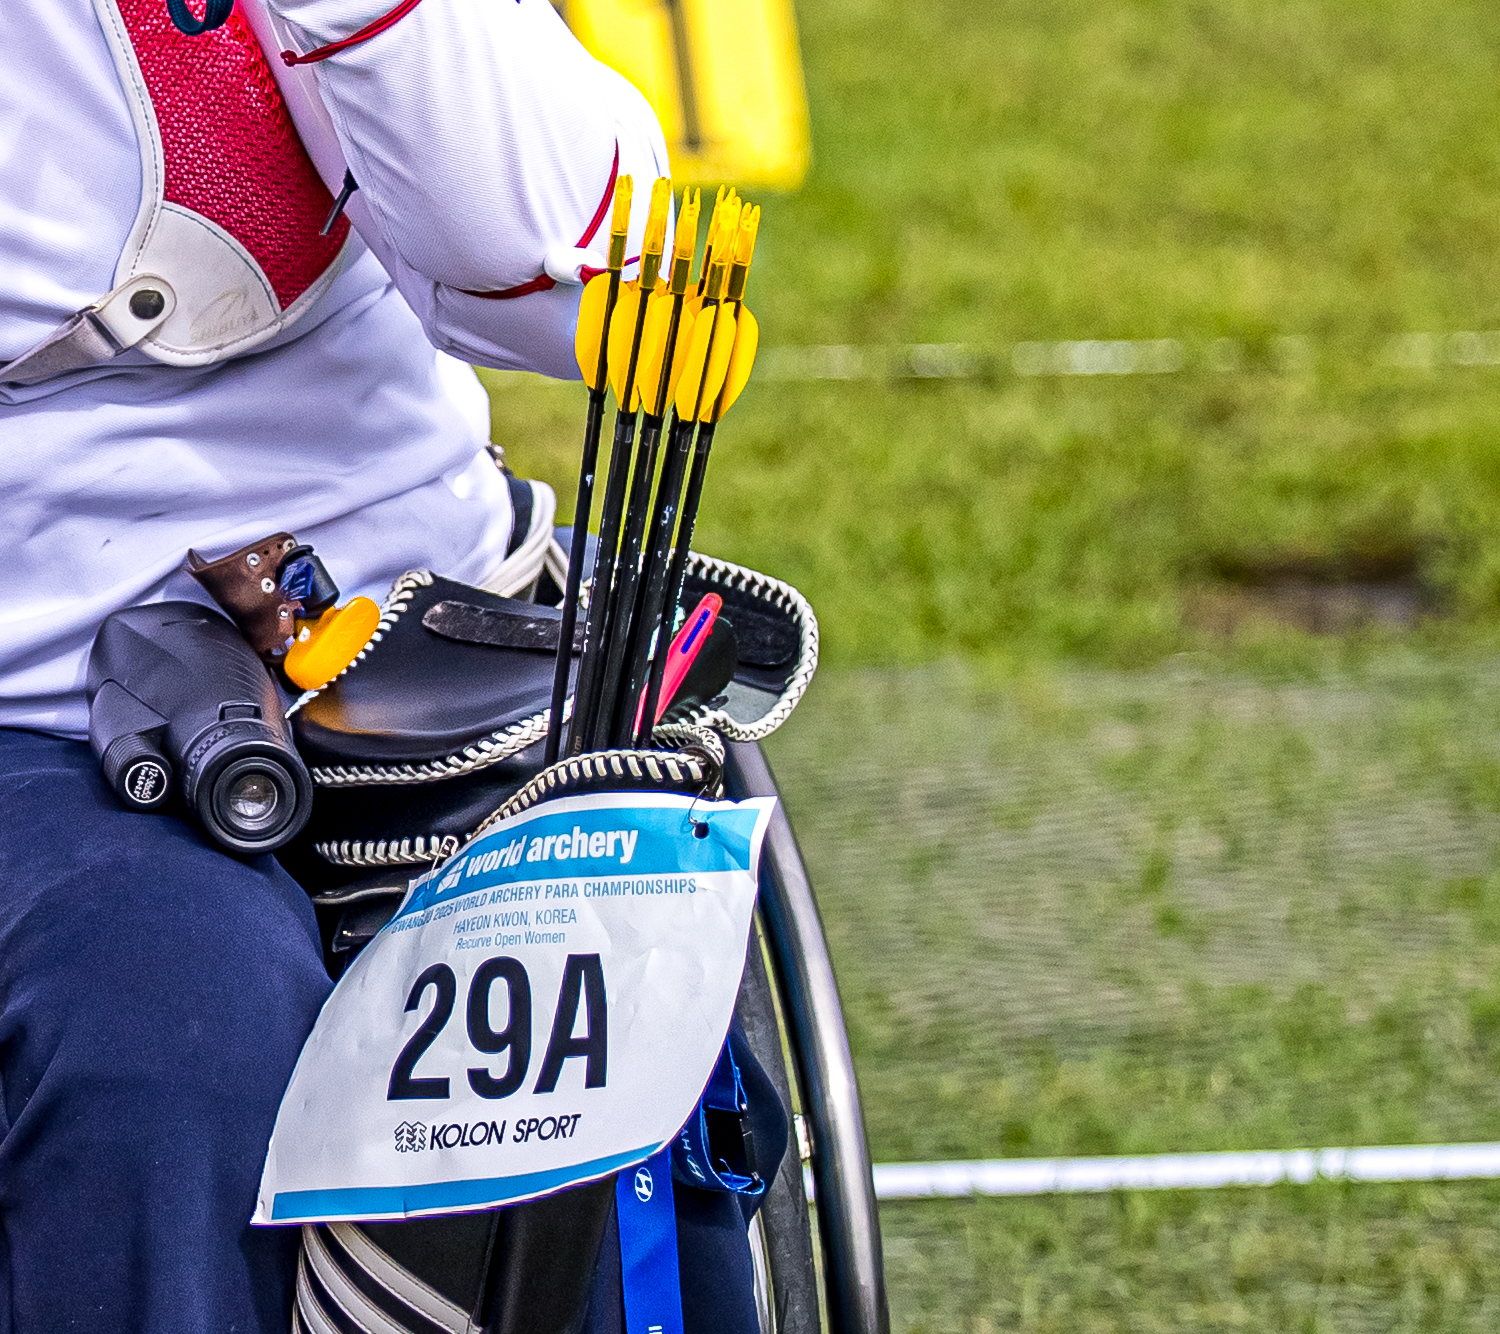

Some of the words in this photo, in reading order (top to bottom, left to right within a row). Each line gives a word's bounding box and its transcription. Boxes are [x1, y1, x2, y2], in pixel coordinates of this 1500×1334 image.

[465, 833, 528, 879] world
[526, 825, 639, 865] archery
[453, 893, 487, 914] WORLD
[487, 884, 541, 906] ARCHERY
[544, 881, 580, 900] PARA
[583, 877, 698, 898] CHAMPIONSHIPS
[452, 913, 491, 934] HAYEON
[492, 910, 533, 930] KWON,
[535, 908, 578, 924] KOREA
[455, 934, 492, 951] Recurve
[494, 932, 523, 947] Open
[524, 931, 566, 945] Women
[387, 953, 608, 1101] 29A
[430, 1119, 506, 1150] KOLON
[513, 1113, 582, 1143] SPORT
